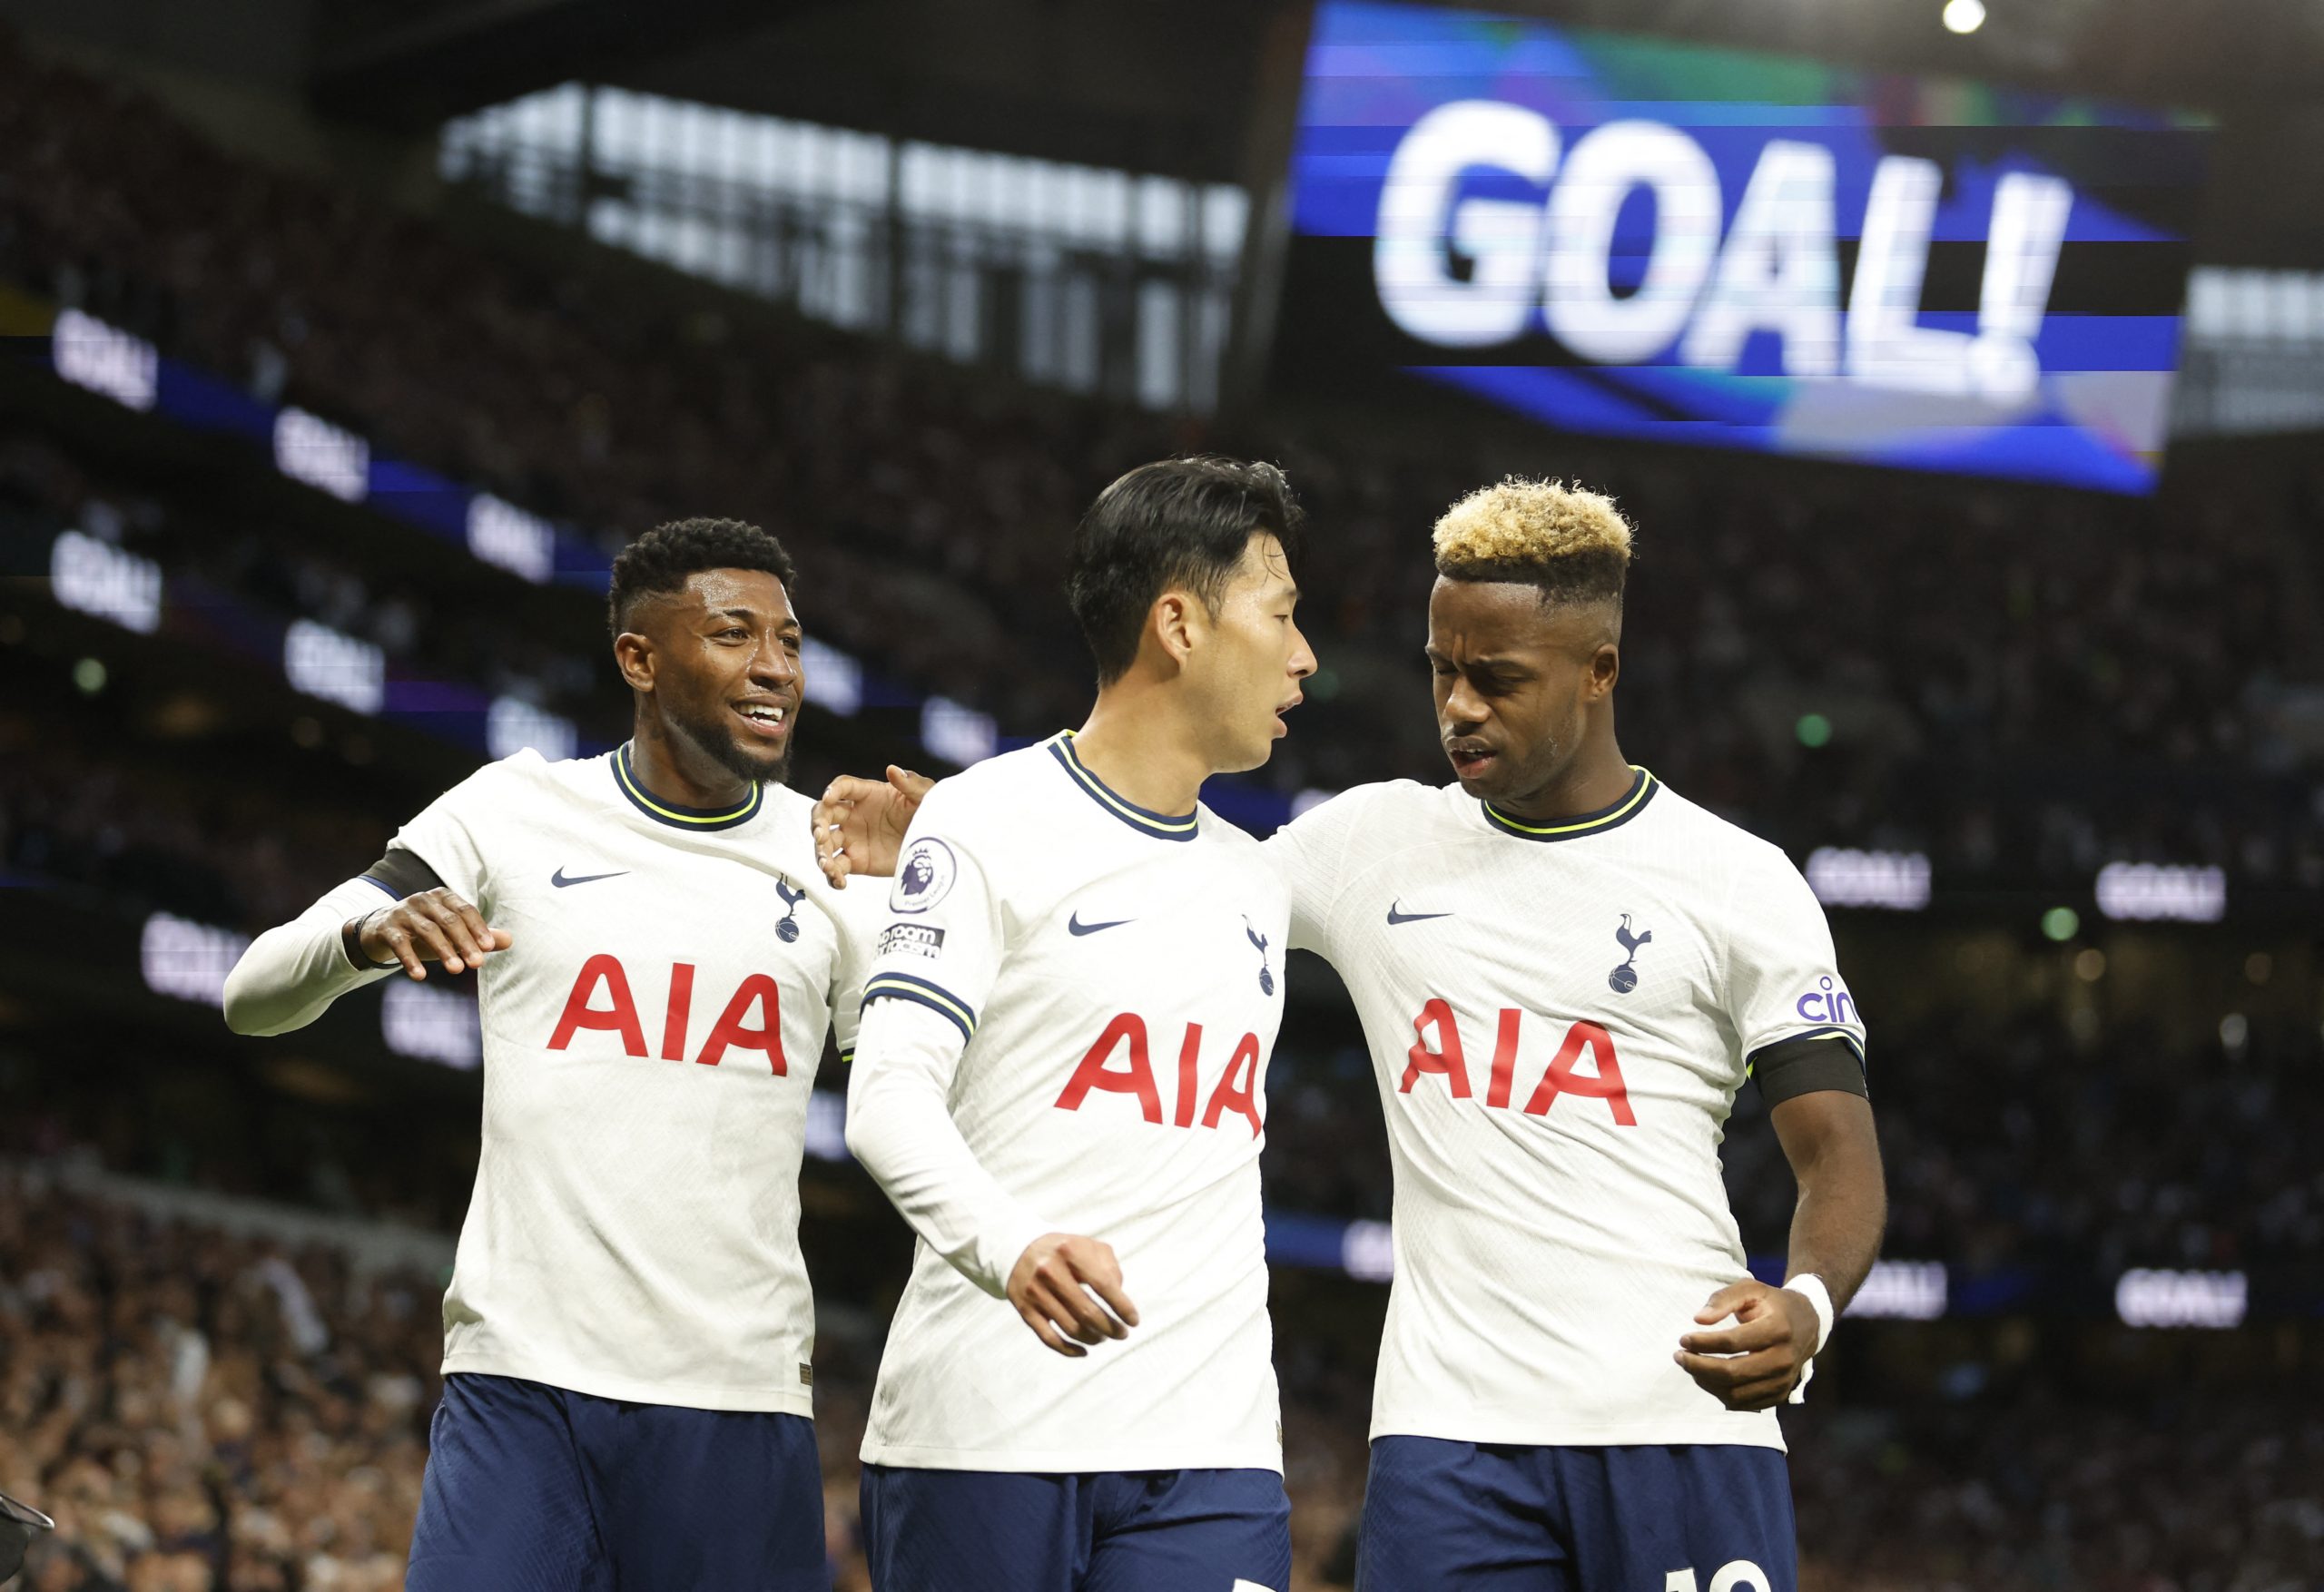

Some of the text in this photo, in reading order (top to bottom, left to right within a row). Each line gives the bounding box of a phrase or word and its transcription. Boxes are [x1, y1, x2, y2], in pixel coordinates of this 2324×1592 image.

[1374, 100, 2073, 405] GOAL!
[547, 954, 788, 1076] AIA
[1054, 1012, 1263, 1141] AIA
[1399, 997, 1637, 1125] AIA
